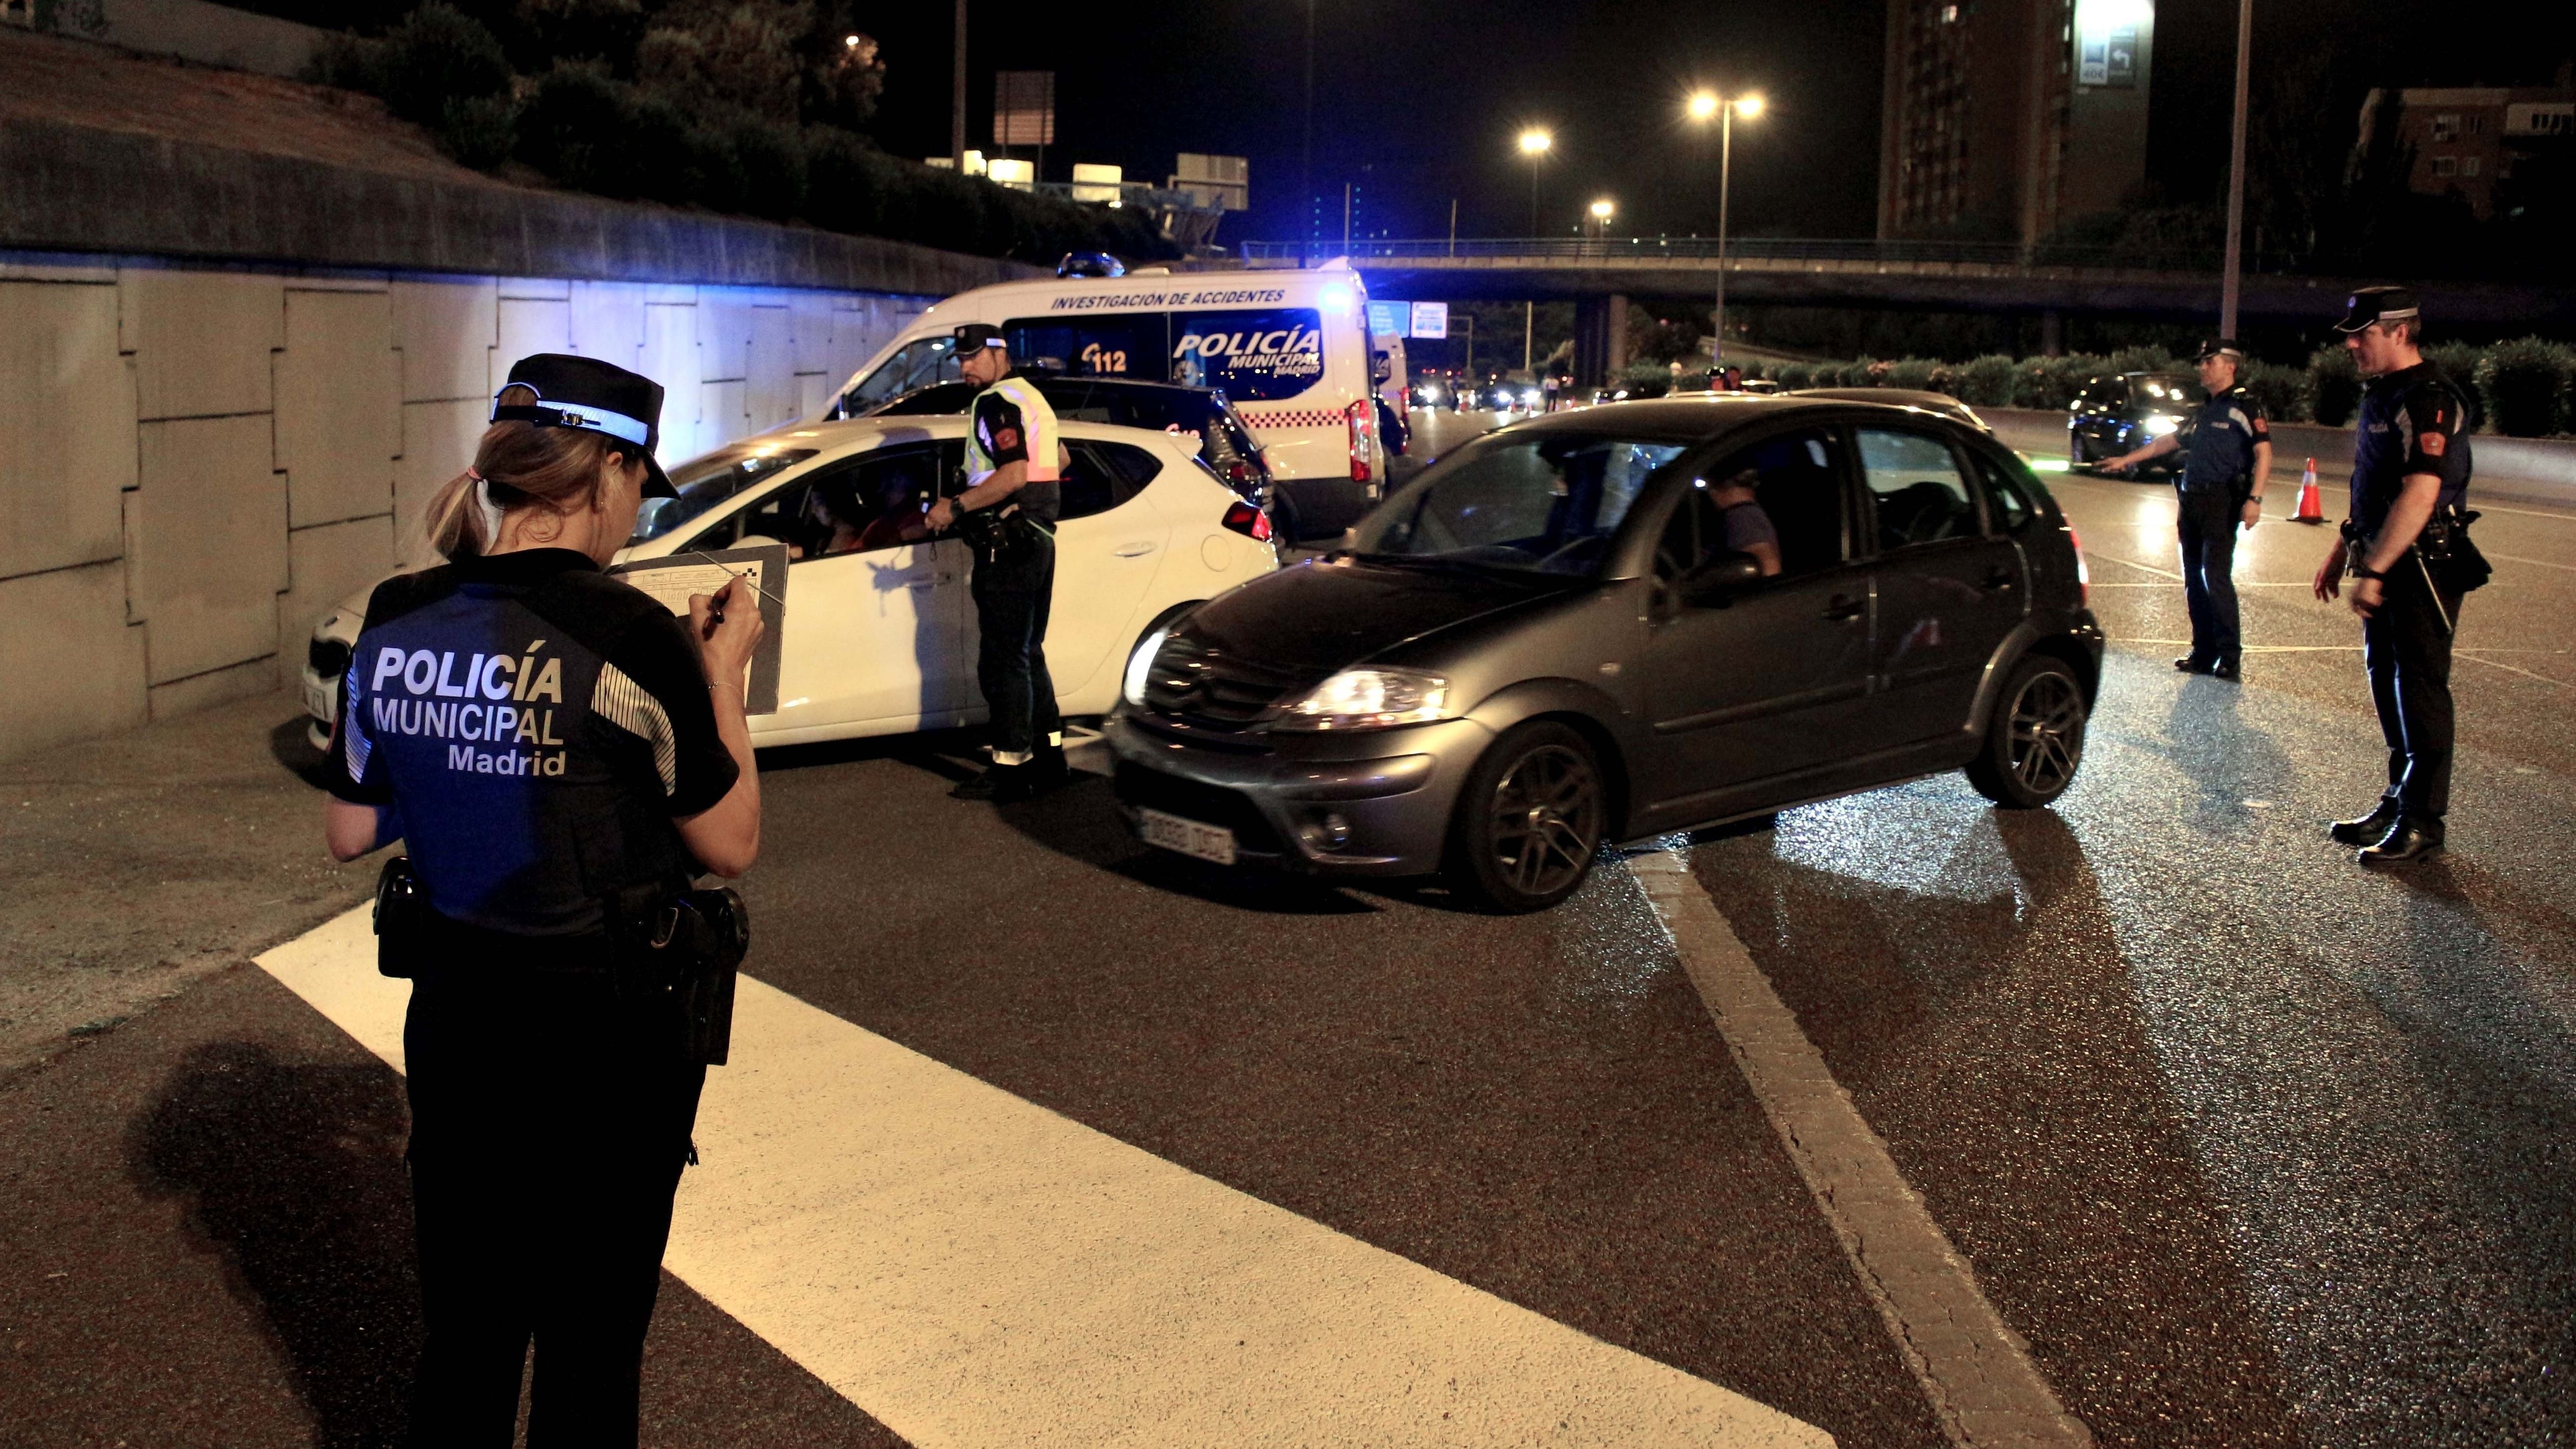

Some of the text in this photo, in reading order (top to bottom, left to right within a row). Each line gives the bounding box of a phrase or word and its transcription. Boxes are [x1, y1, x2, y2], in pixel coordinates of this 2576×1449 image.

[1051, 289, 1285, 310] INVESTIGACIÓN DE ACCIDENTES
[1173, 324, 1321, 358] POLICÍA
[1228, 352, 1320, 369] MUNICIPAL
[1274, 365, 1321, 375] MADRID
[372, 640, 562, 704] POLICÍA
[373, 697, 564, 745] MUNICIPAL
[448, 744, 566, 776] Madrid
